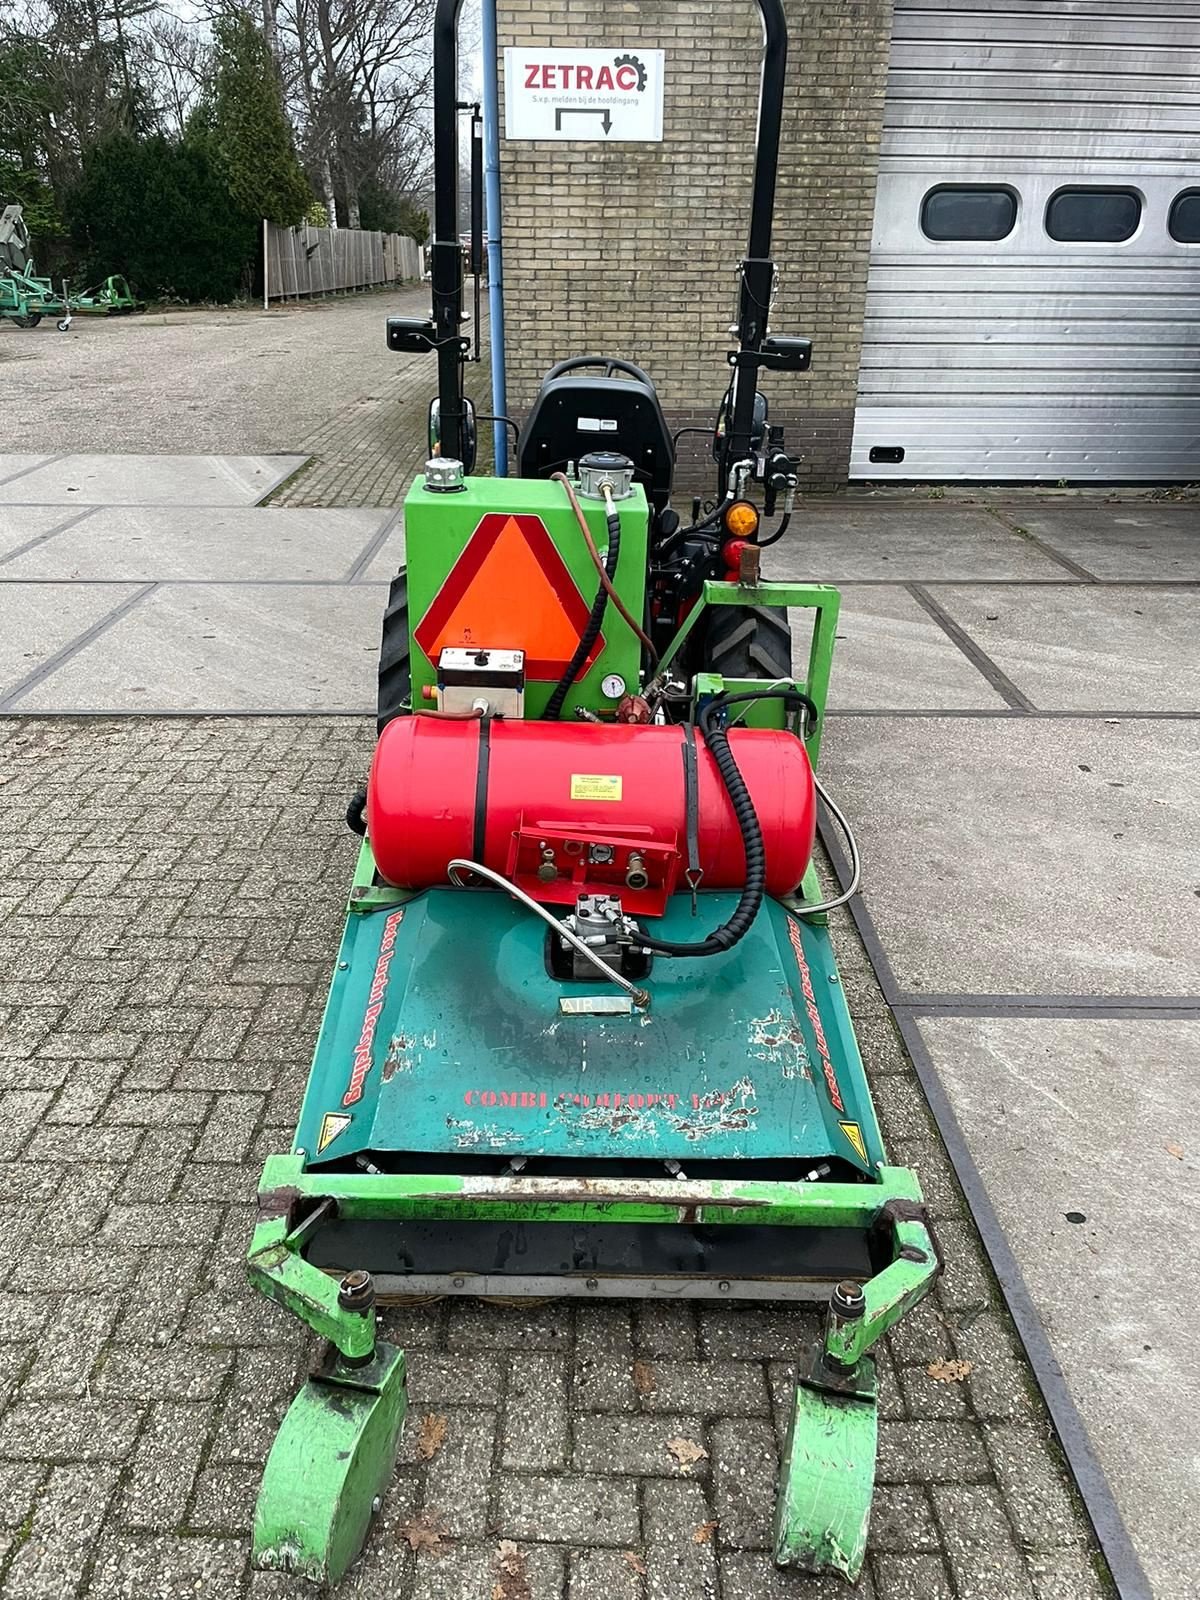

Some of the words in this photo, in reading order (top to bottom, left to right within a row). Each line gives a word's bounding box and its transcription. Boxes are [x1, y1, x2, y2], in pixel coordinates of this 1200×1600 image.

[524, 64, 636, 91] ZETRAC
[532, 95, 550, 104] S.v.p.
[551, 96, 577, 104] melden
[578, 96, 587, 106] bij
[368, 949, 394, 1005] Lucht
[343, 1002, 383, 1108] Recycling
[463, 1090, 547, 1108] COMBI
